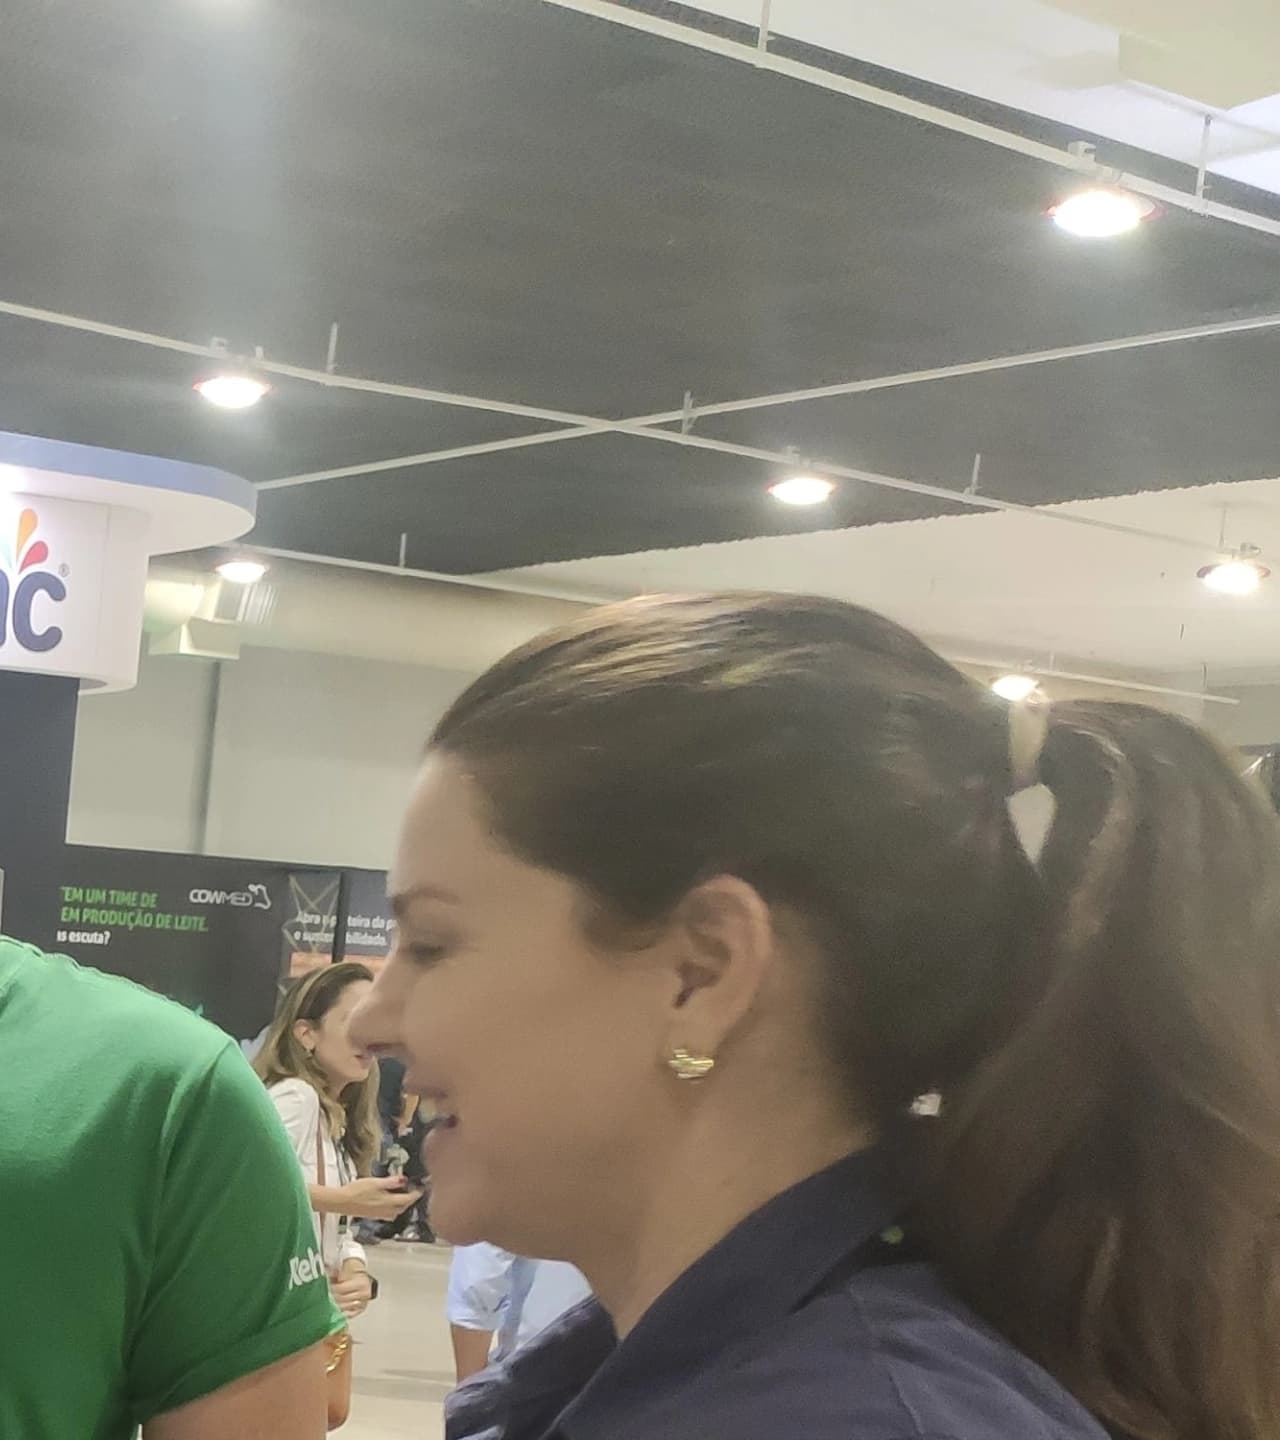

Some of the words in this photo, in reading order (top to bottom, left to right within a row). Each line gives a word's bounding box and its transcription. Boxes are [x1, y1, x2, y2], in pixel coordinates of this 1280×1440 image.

[109, 889, 138, 907] TIME
[140, 892, 158, 909] DE
[61, 906, 80, 922] EM
[81, 907, 153, 931] PRODUÇÃO
[155, 912, 172, 929] DE
[68, 930, 111, 946] escuta?
